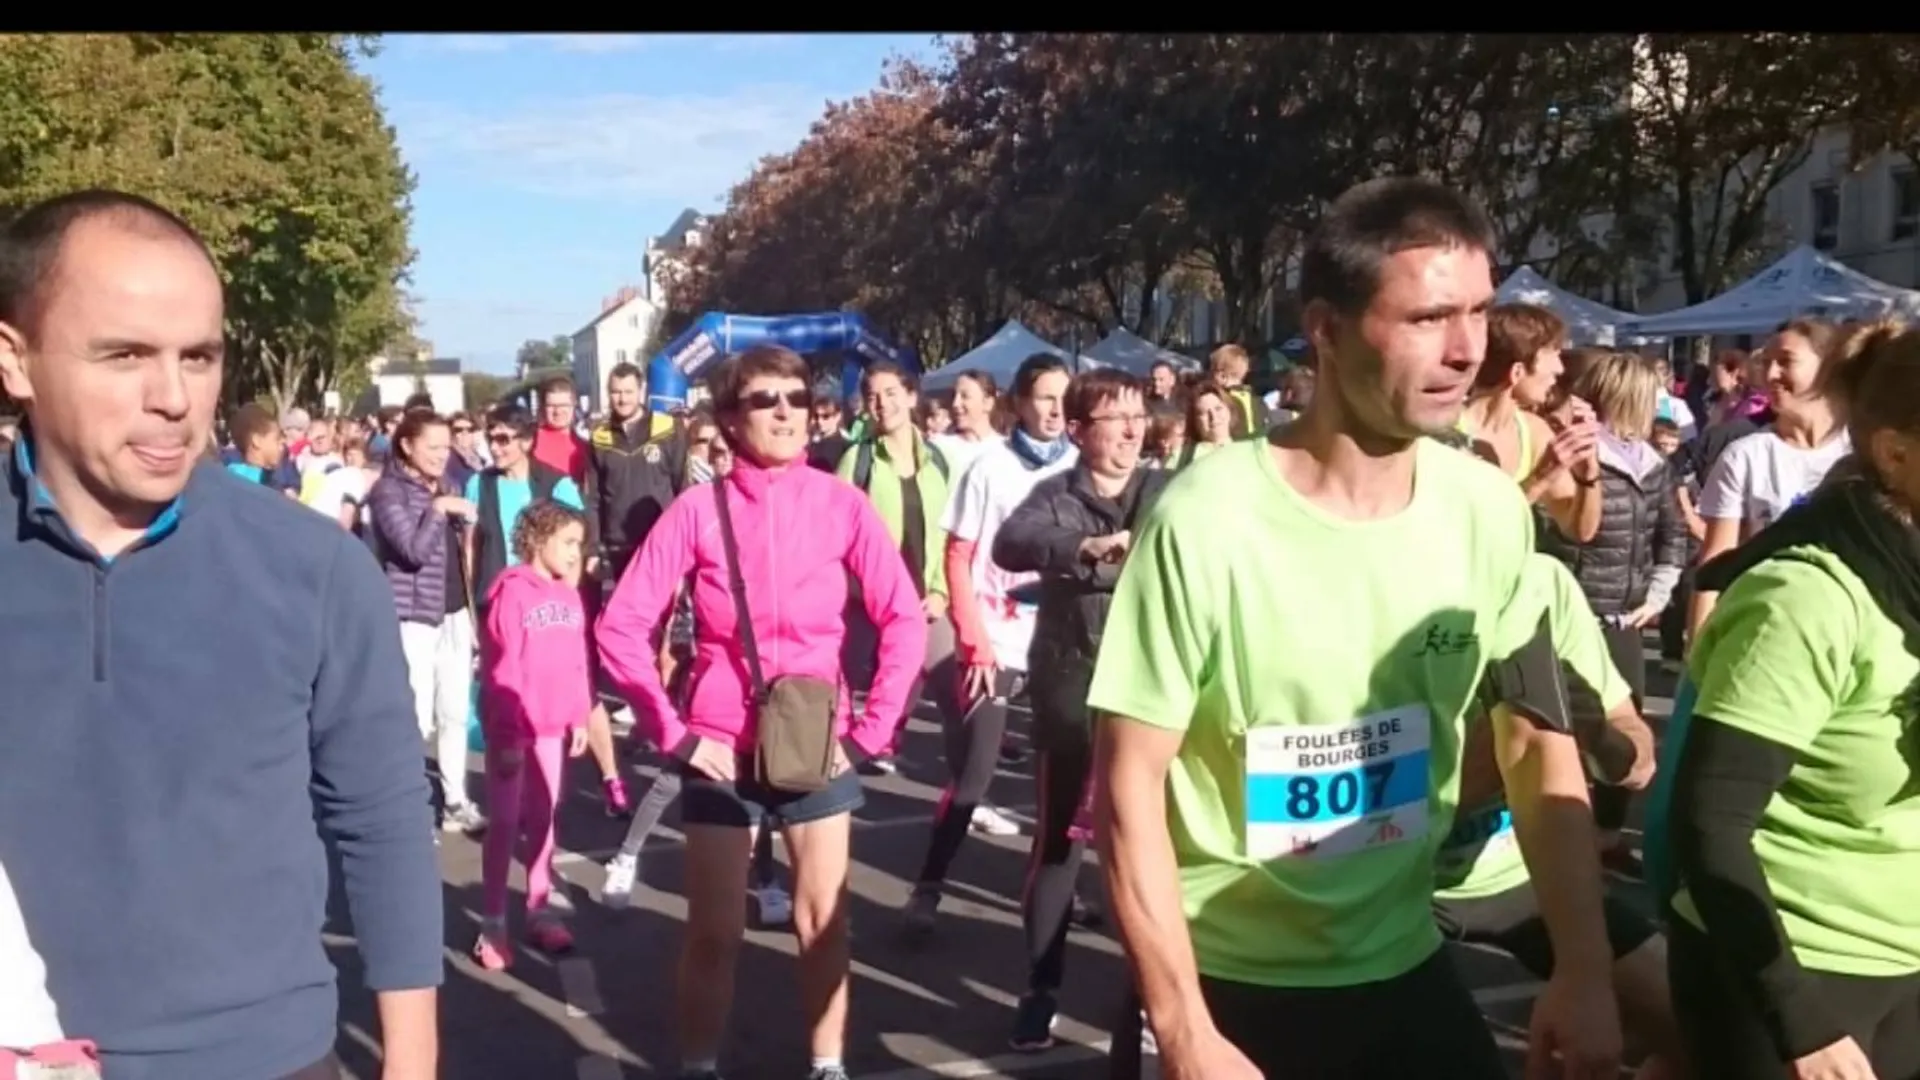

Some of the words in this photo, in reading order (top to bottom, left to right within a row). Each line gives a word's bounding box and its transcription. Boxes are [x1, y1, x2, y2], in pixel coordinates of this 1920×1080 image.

[1379, 718, 1401, 736] DE
[1298, 741, 1389, 767] BOURGES
[1287, 762, 1395, 819] 807
